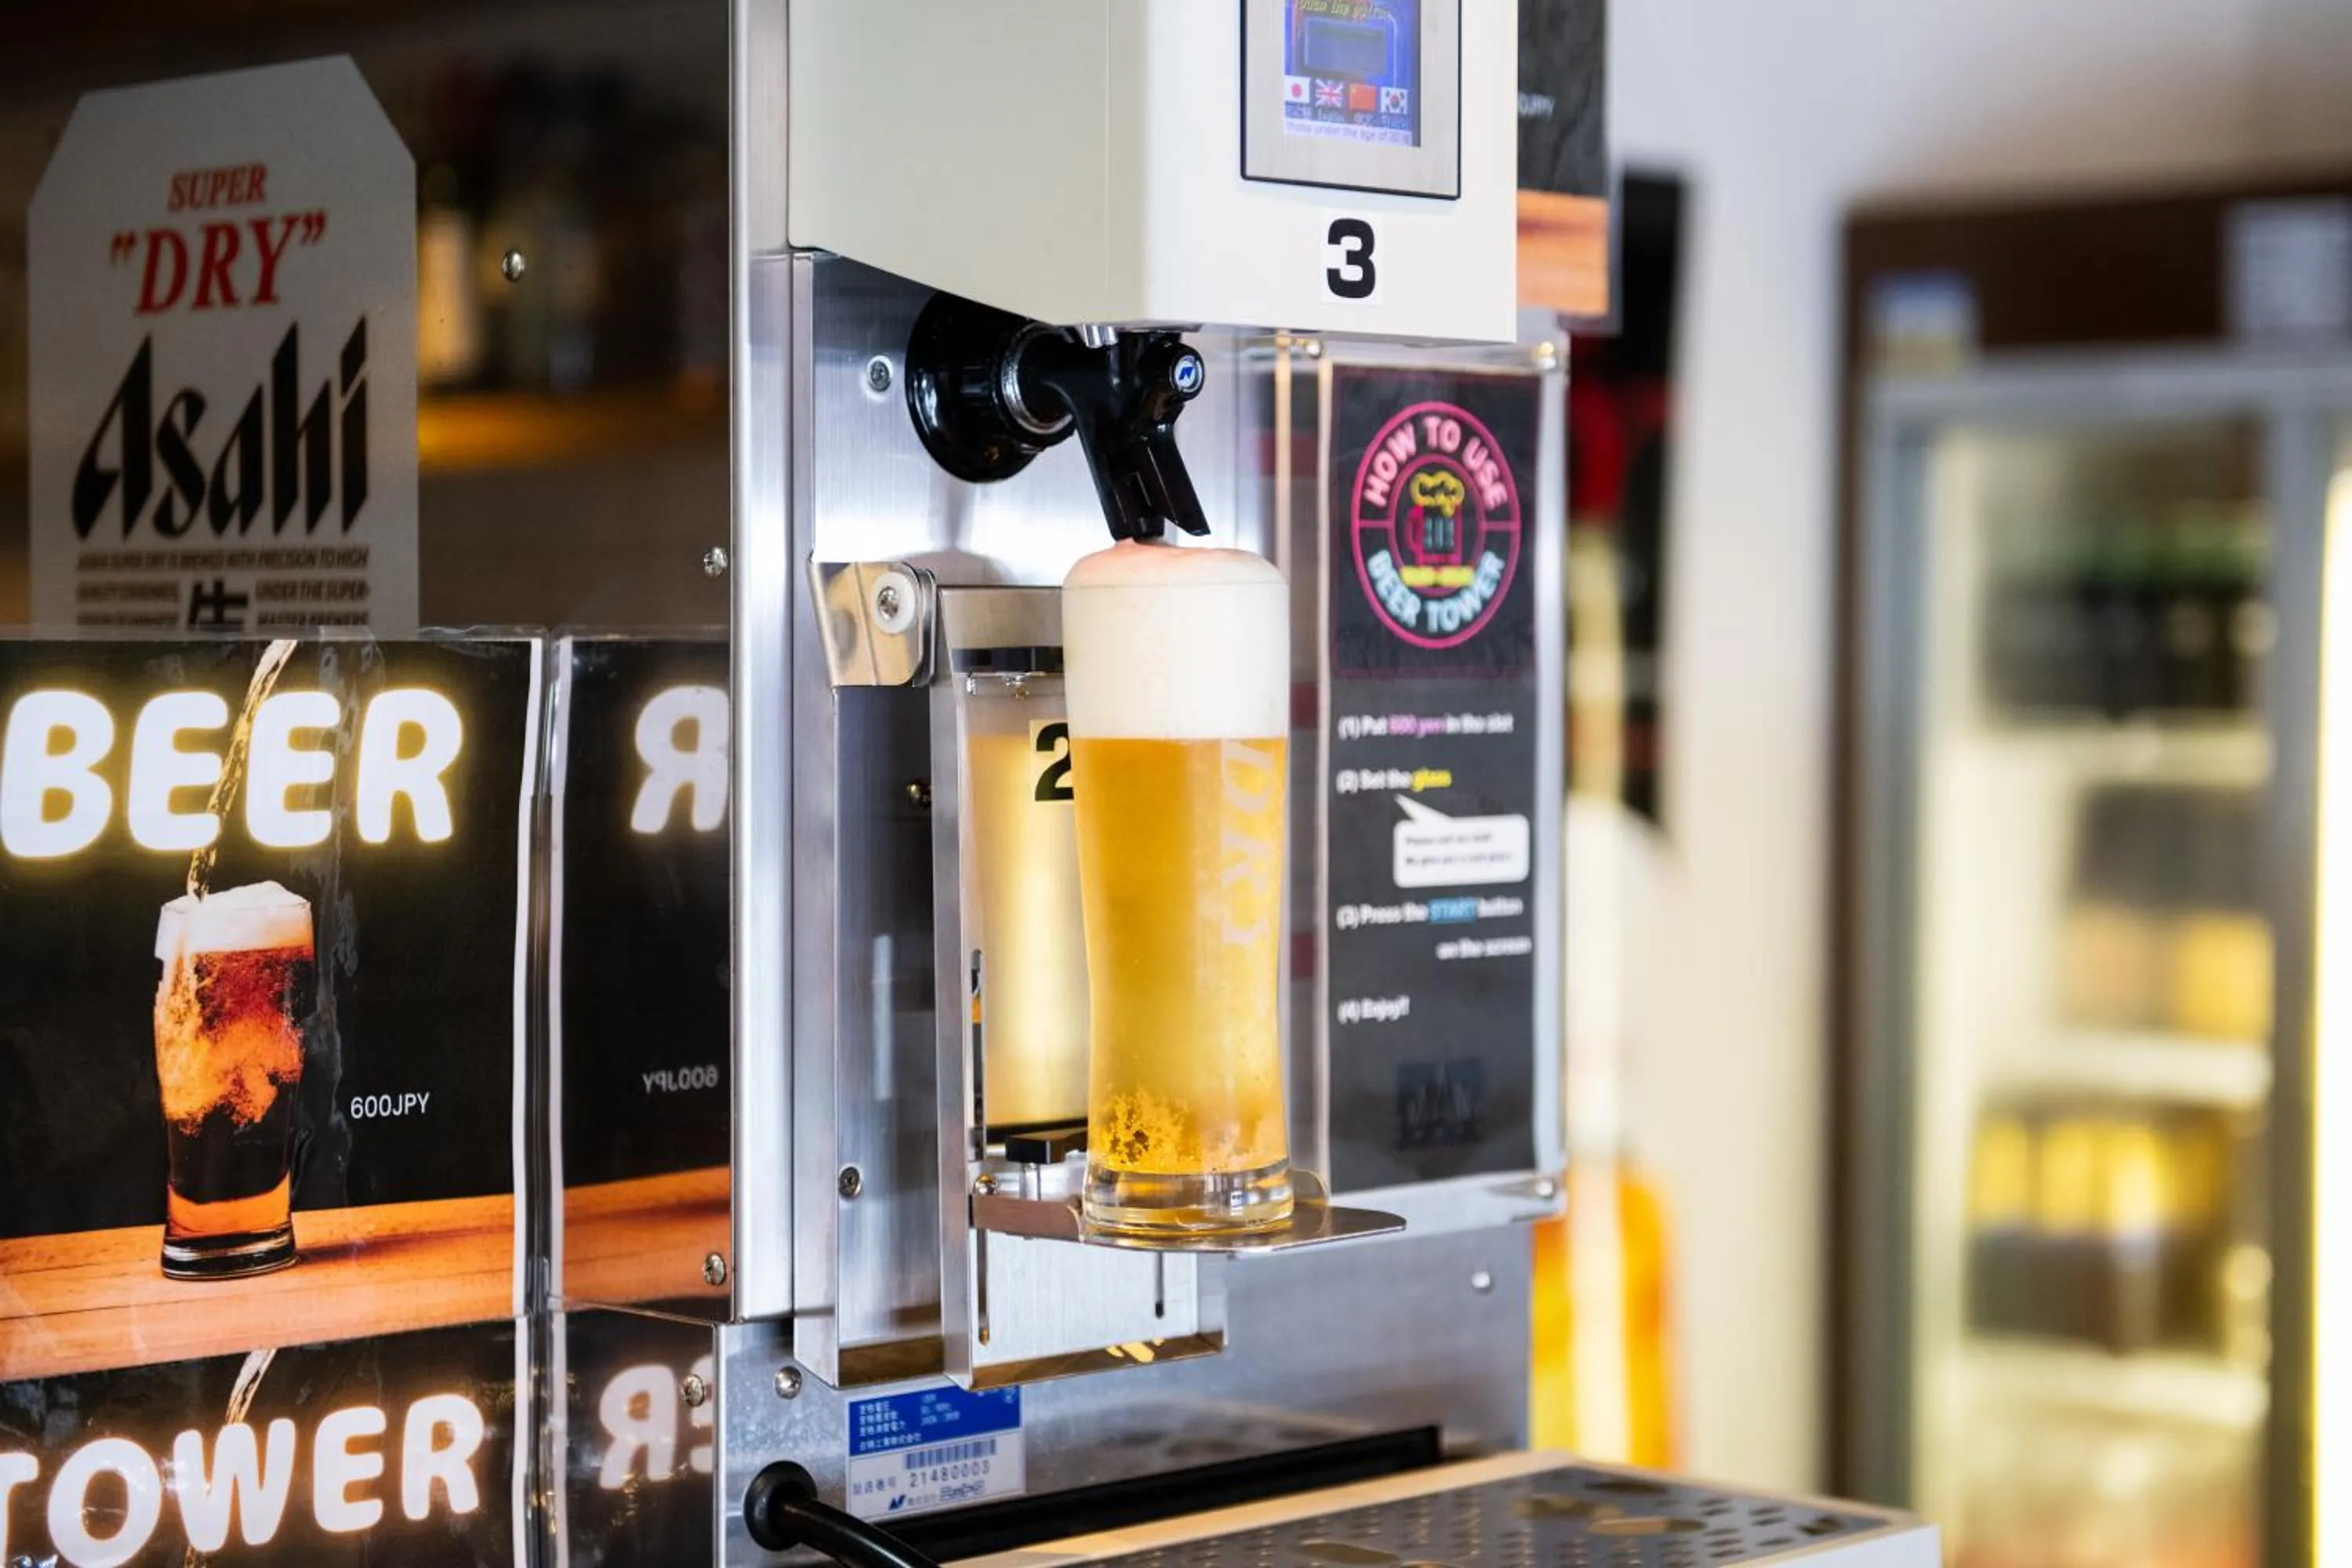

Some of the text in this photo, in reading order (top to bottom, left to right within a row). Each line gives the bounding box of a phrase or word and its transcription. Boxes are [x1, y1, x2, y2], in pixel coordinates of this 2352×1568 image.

[168, 162, 267, 211] SUPER
[1327, 218, 1376, 298] 3
[71, 315, 368, 542] Asahi
[1364, 416, 1508, 510] HOW TO USE
[1368, 550, 1505, 633] BEER TOWER
[0, 689, 463, 858] BEER
[1035, 722, 1074, 801] 2
[1360, 903, 1403, 925] Press
[1429, 899, 1476, 922] START
[350, 1091, 430, 1120] 600JPY
